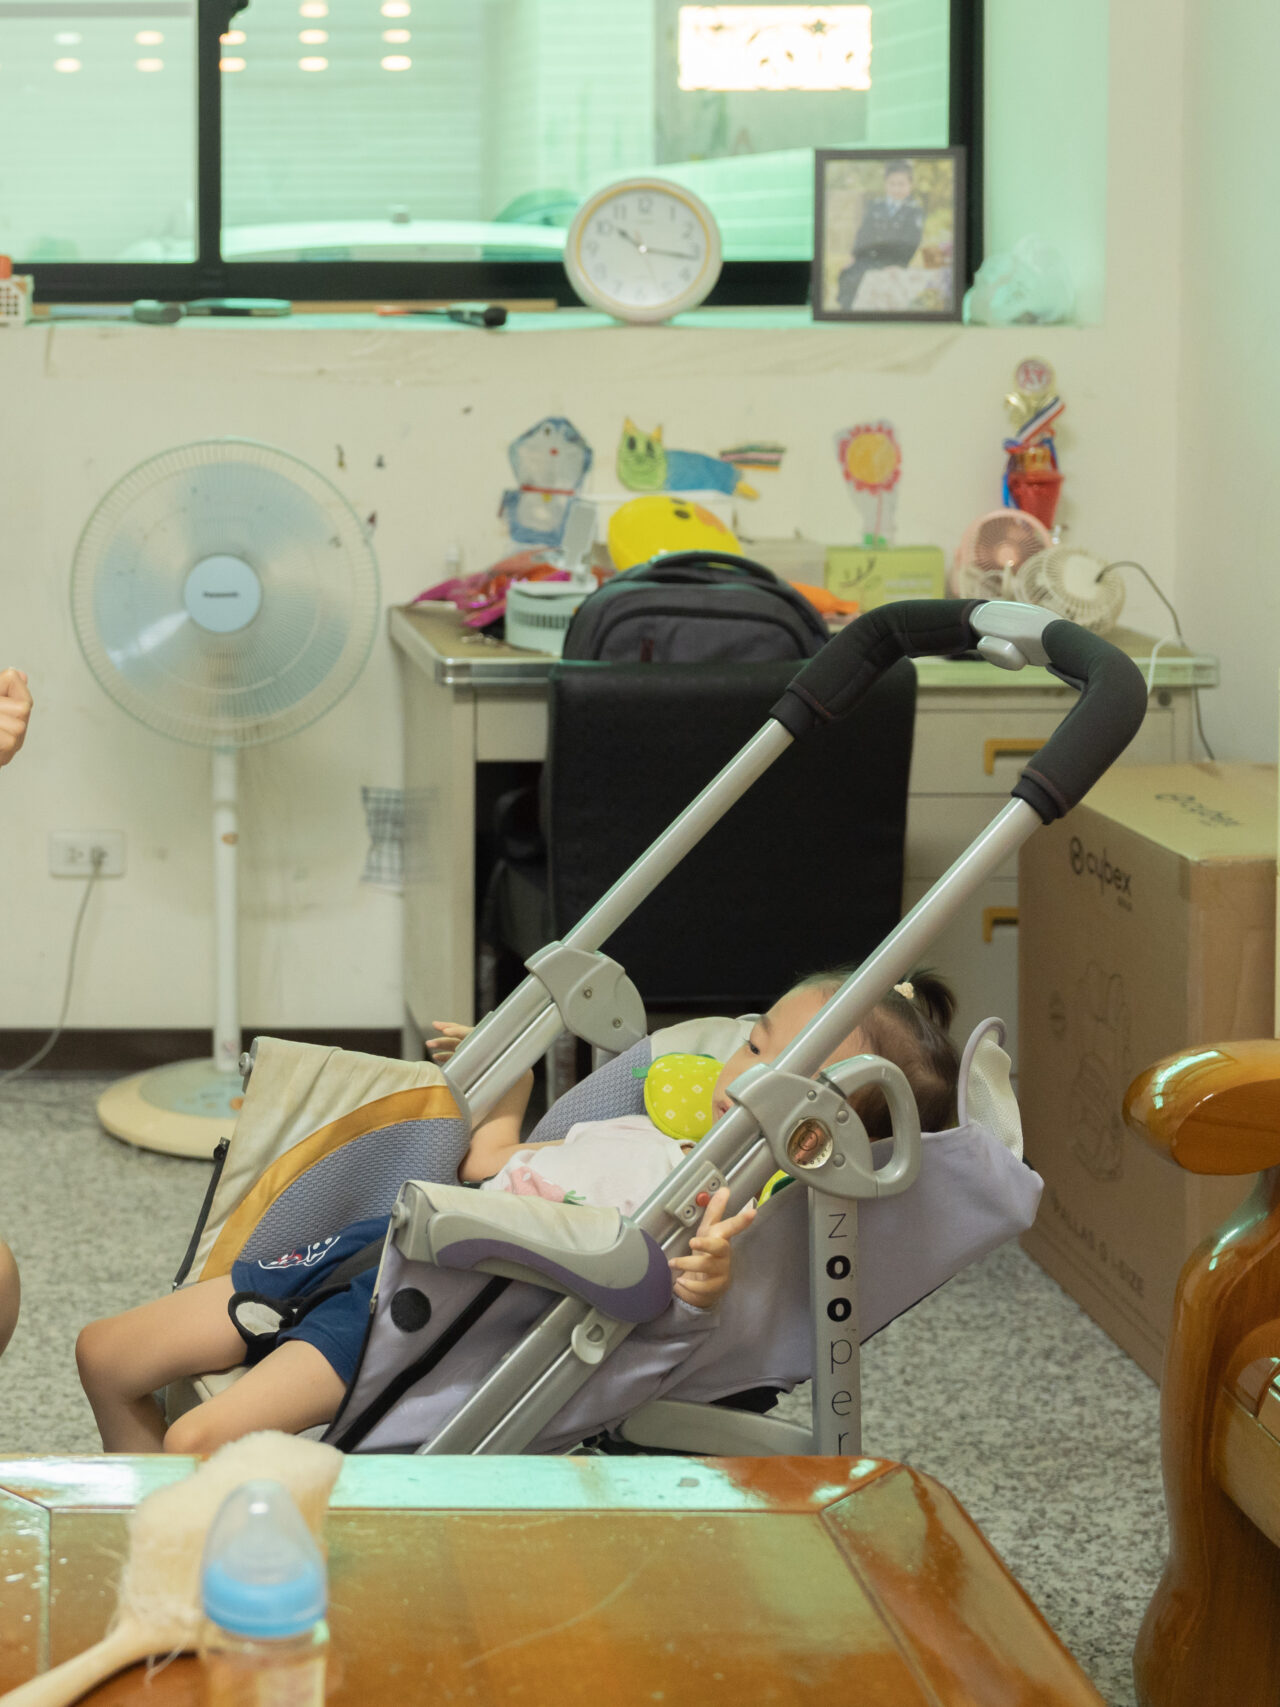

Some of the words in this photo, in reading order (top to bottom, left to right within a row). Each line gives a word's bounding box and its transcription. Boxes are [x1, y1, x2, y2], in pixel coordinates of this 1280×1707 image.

[613, 204, 627, 222] 11
[637, 197, 653, 215] 12
[1086, 847, 1132, 897] cybex
[826, 1213, 853, 1456] zooper
